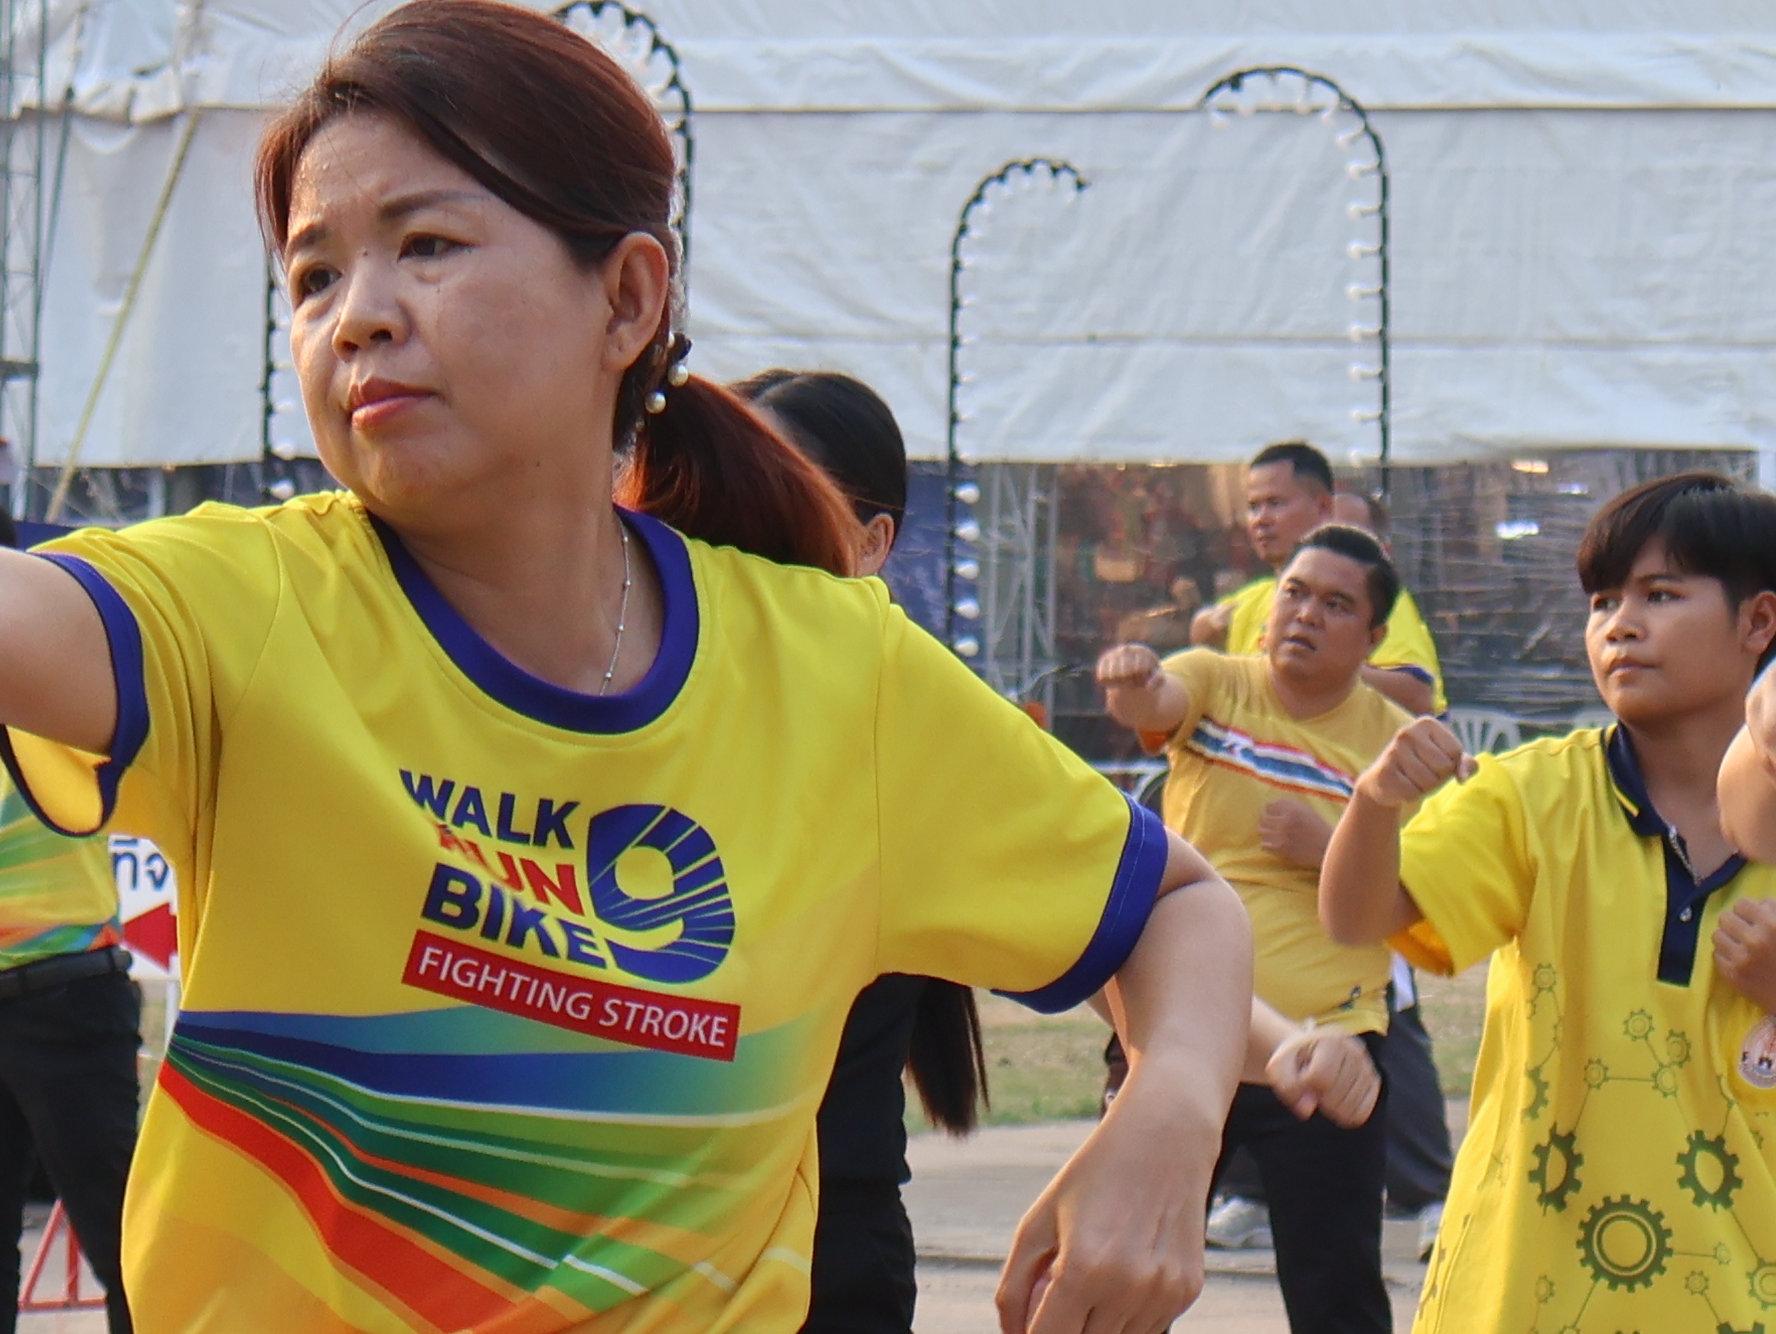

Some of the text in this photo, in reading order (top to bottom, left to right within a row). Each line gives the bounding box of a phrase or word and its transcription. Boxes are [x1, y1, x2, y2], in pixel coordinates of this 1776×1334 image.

[399, 768, 581, 850] WALK
[421, 862, 608, 969] BIKE
[435, 822, 585, 916] RUN
[418, 946, 729, 1048] FIGHTING STROKE
